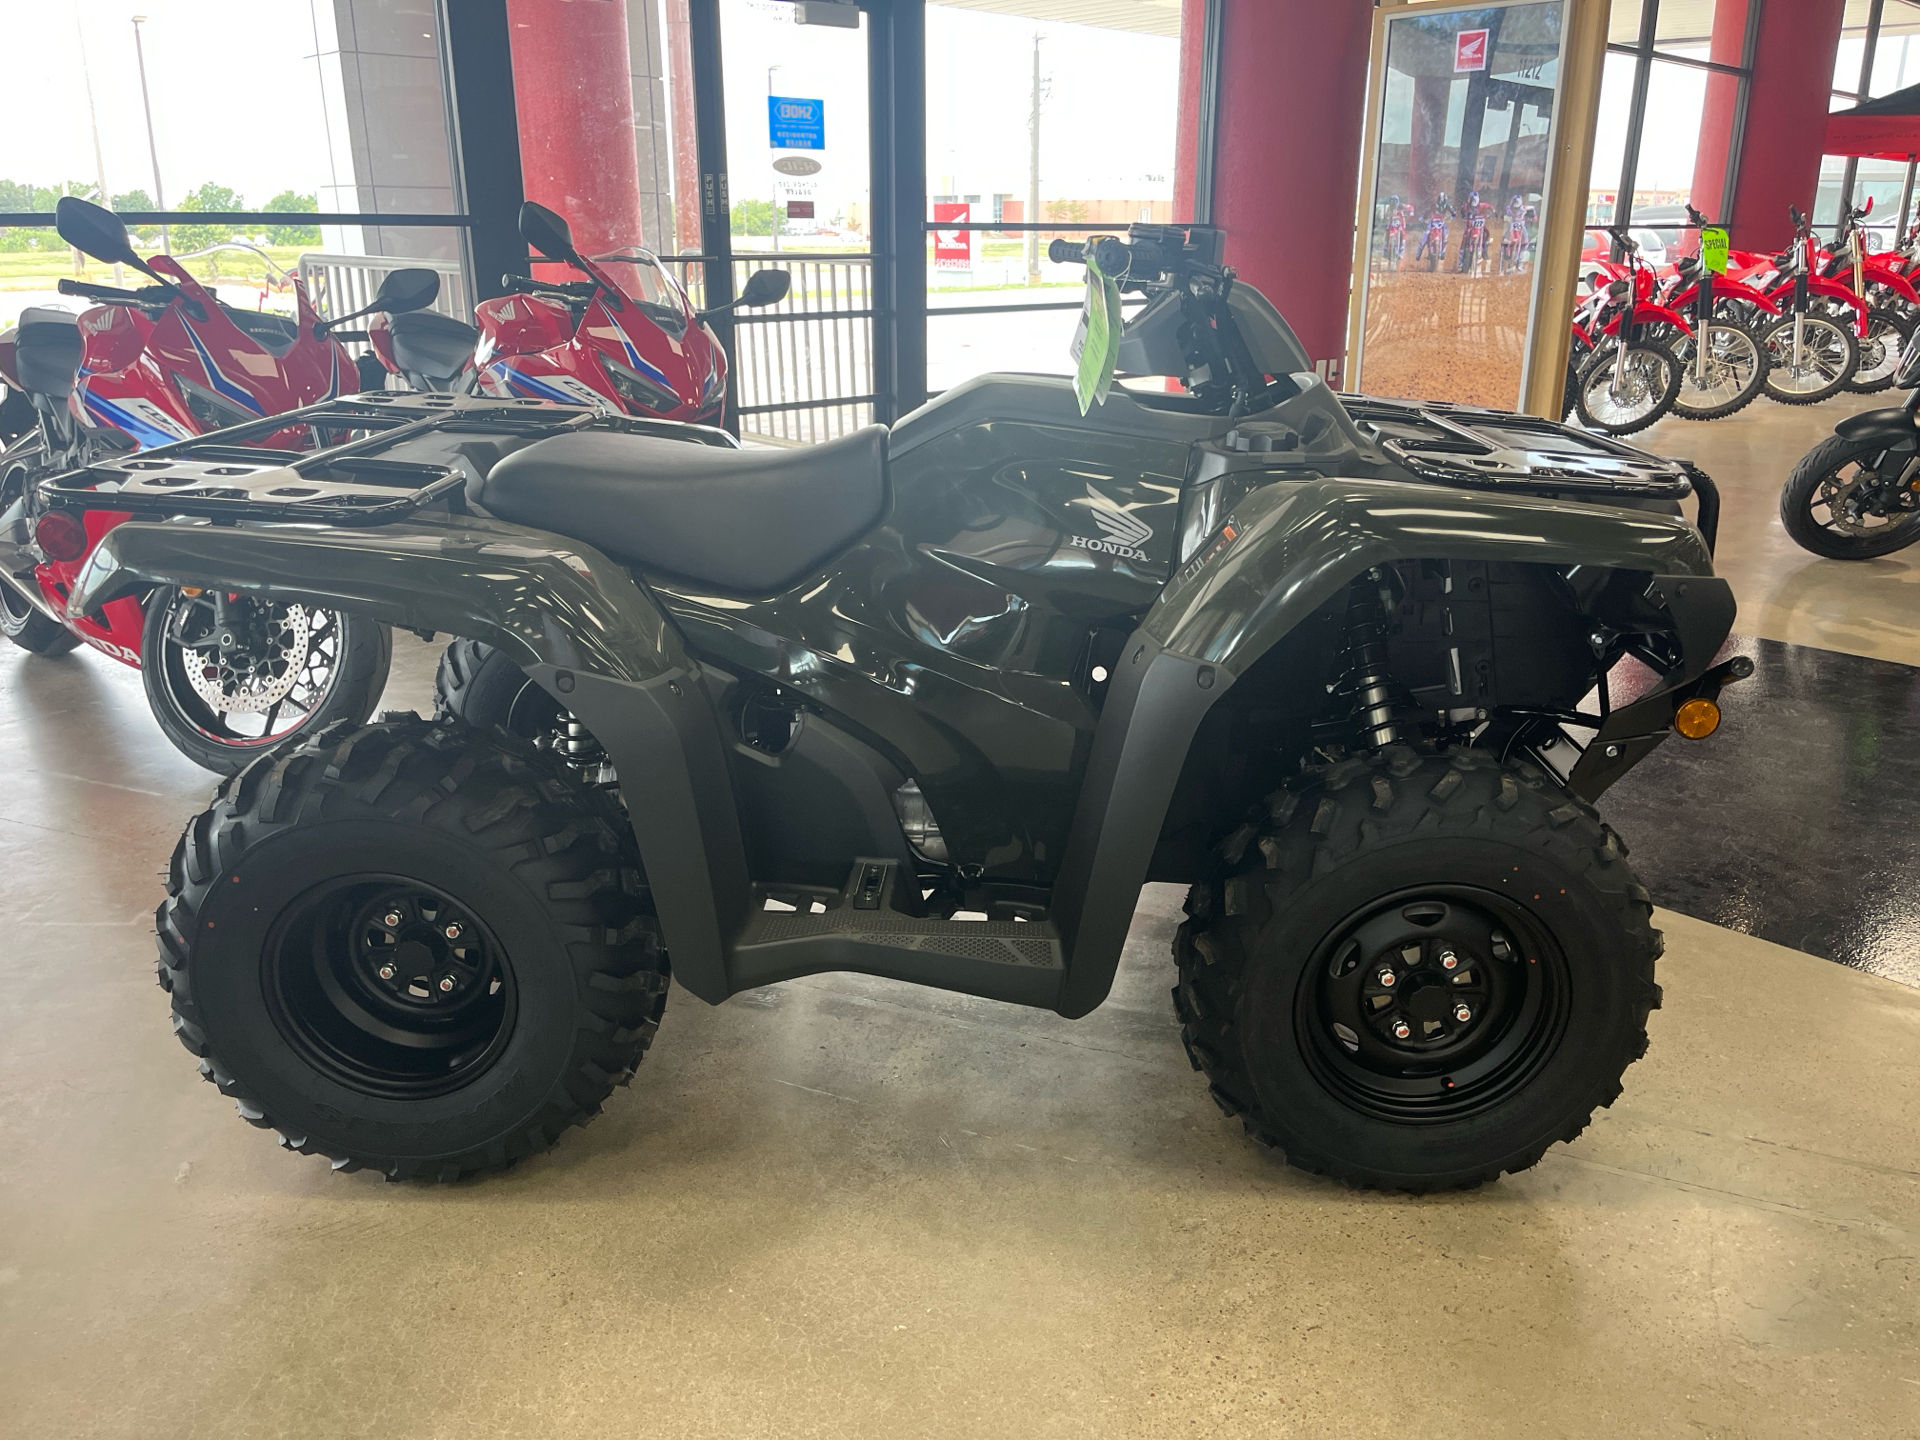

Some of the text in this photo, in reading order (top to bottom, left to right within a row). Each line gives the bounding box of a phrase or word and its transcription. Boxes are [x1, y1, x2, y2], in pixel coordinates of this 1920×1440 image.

[706, 175, 714, 206] PUSH
[720, 175, 728, 206] PUSH
[937, 242, 968, 250] HONDA
[1704, 238, 1728, 250] SPECIAL
[249, 327, 288, 338] HONDA
[1070, 534, 1150, 563] HONDA
